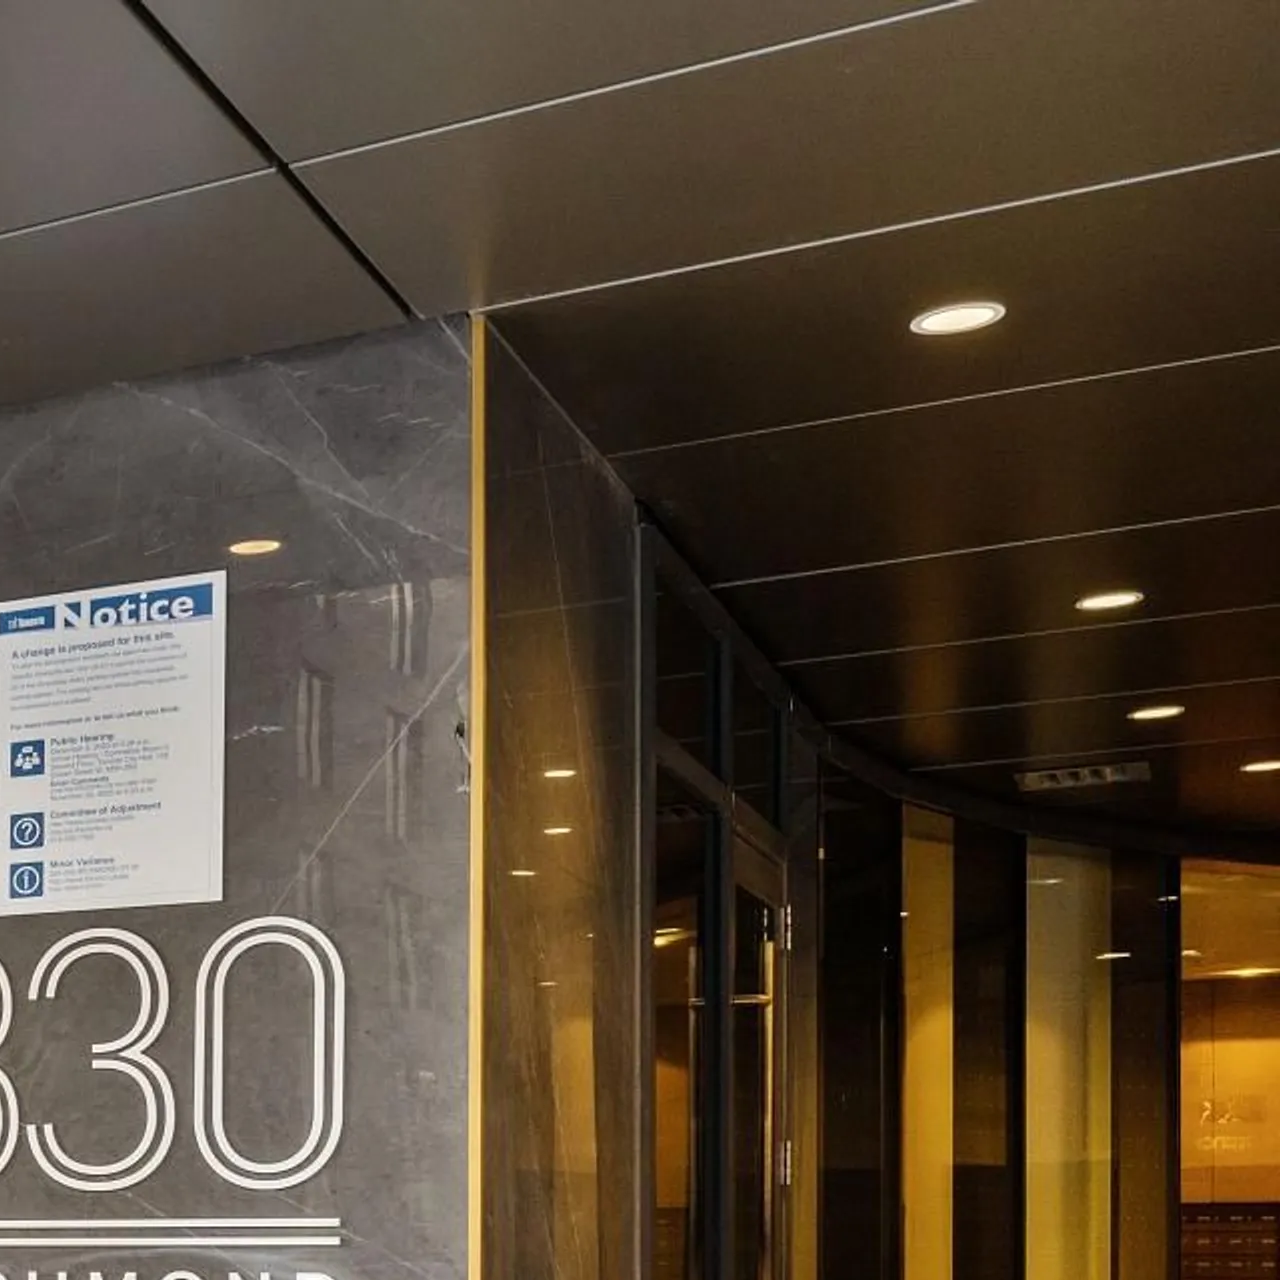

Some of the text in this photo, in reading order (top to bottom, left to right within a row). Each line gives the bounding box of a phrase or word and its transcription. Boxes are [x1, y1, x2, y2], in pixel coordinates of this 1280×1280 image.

[58, 591, 194, 630] Notice
[12, 651, 19, 660] A
[69, 638, 115, 655] proposed
[117, 636, 130, 646] for
